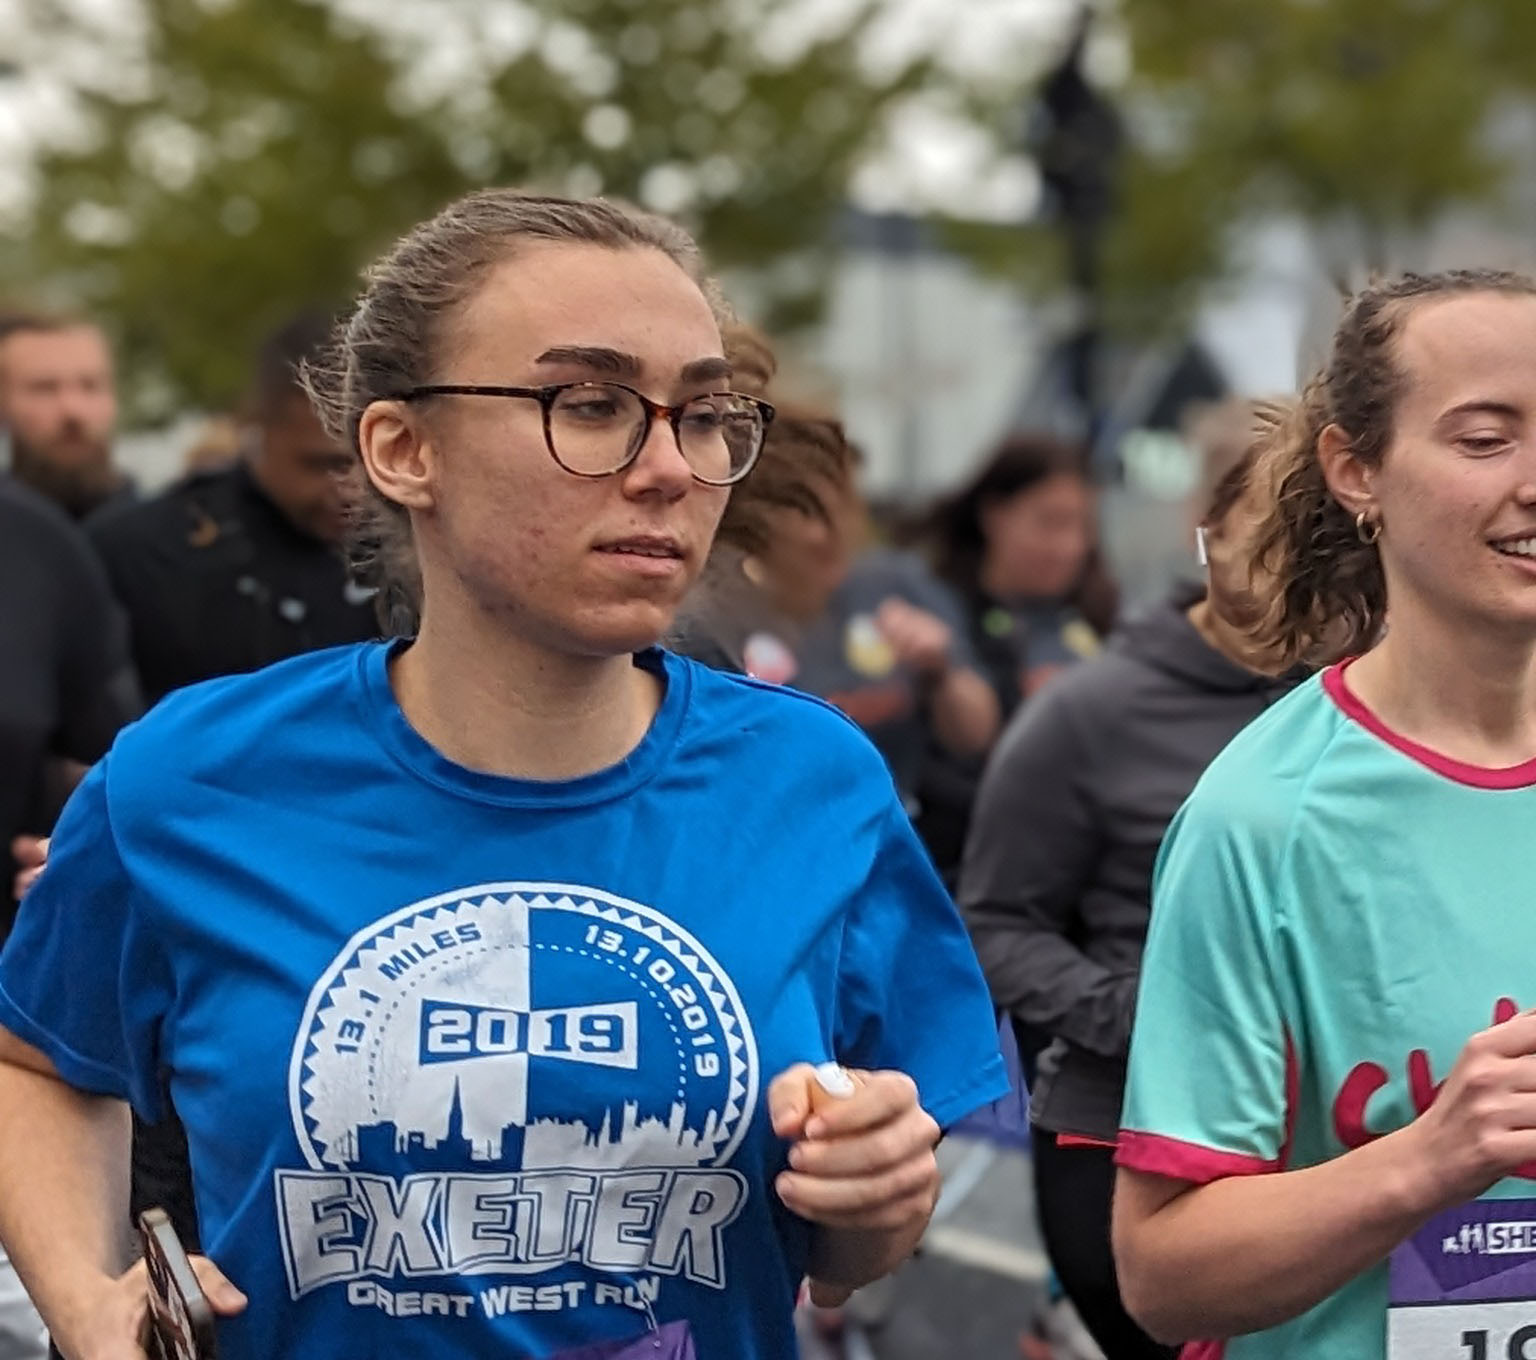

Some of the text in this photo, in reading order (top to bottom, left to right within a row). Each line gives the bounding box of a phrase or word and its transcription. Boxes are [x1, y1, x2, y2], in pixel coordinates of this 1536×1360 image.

[335, 922, 720, 1078] 13.1 MILES 13.10.2019
[427, 1009, 625, 1055] 2019
[274, 1167, 748, 1301] EXETER
[348, 1276, 660, 1320] GREAT WEST RUN
